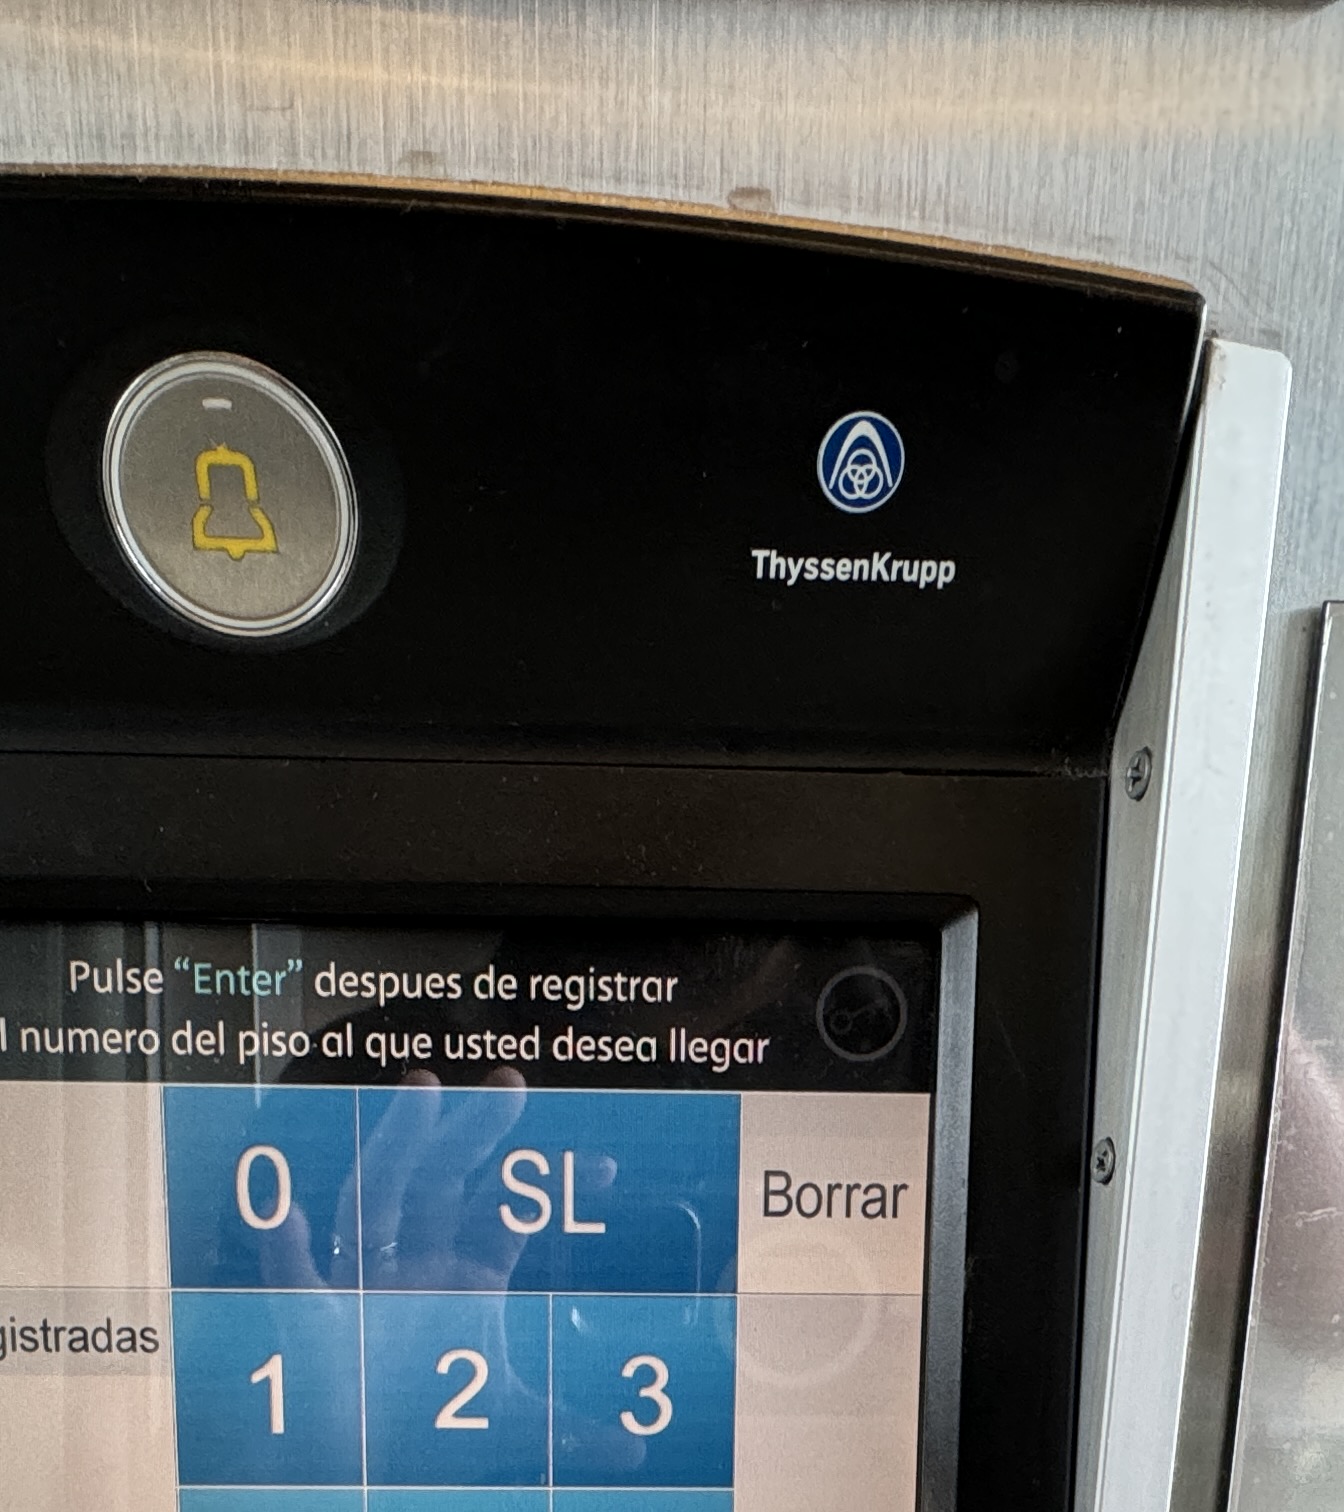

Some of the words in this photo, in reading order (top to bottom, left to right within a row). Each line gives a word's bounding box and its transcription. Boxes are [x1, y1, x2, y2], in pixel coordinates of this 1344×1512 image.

[751, 548, 956, 590] ThyssenKrupp
[69, 958, 163, 995] Pulse
[314, 964, 461, 1004] despues
[474, 967, 518, 1002] de
[528, 969, 678, 1010] registrar
[20, 1025, 159, 1057] numero
[171, 1021, 226, 1058] del
[239, 1024, 310, 1068] piso
[321, 1023, 355, 1060] al
[366, 1030, 433, 1072] que
[444, 1025, 540, 1063] usted
[551, 1026, 657, 1065] desea
[668, 1028, 770, 1073] llegar
[234, 1145, 293, 1232] 0
[498, 1149, 606, 1235] SL
[761, 1169, 908, 1219] Borrar
[251, 1353, 288, 1435] 1
[434, 1347, 490, 1430] 2
[620, 1354, 673, 1435] 3
